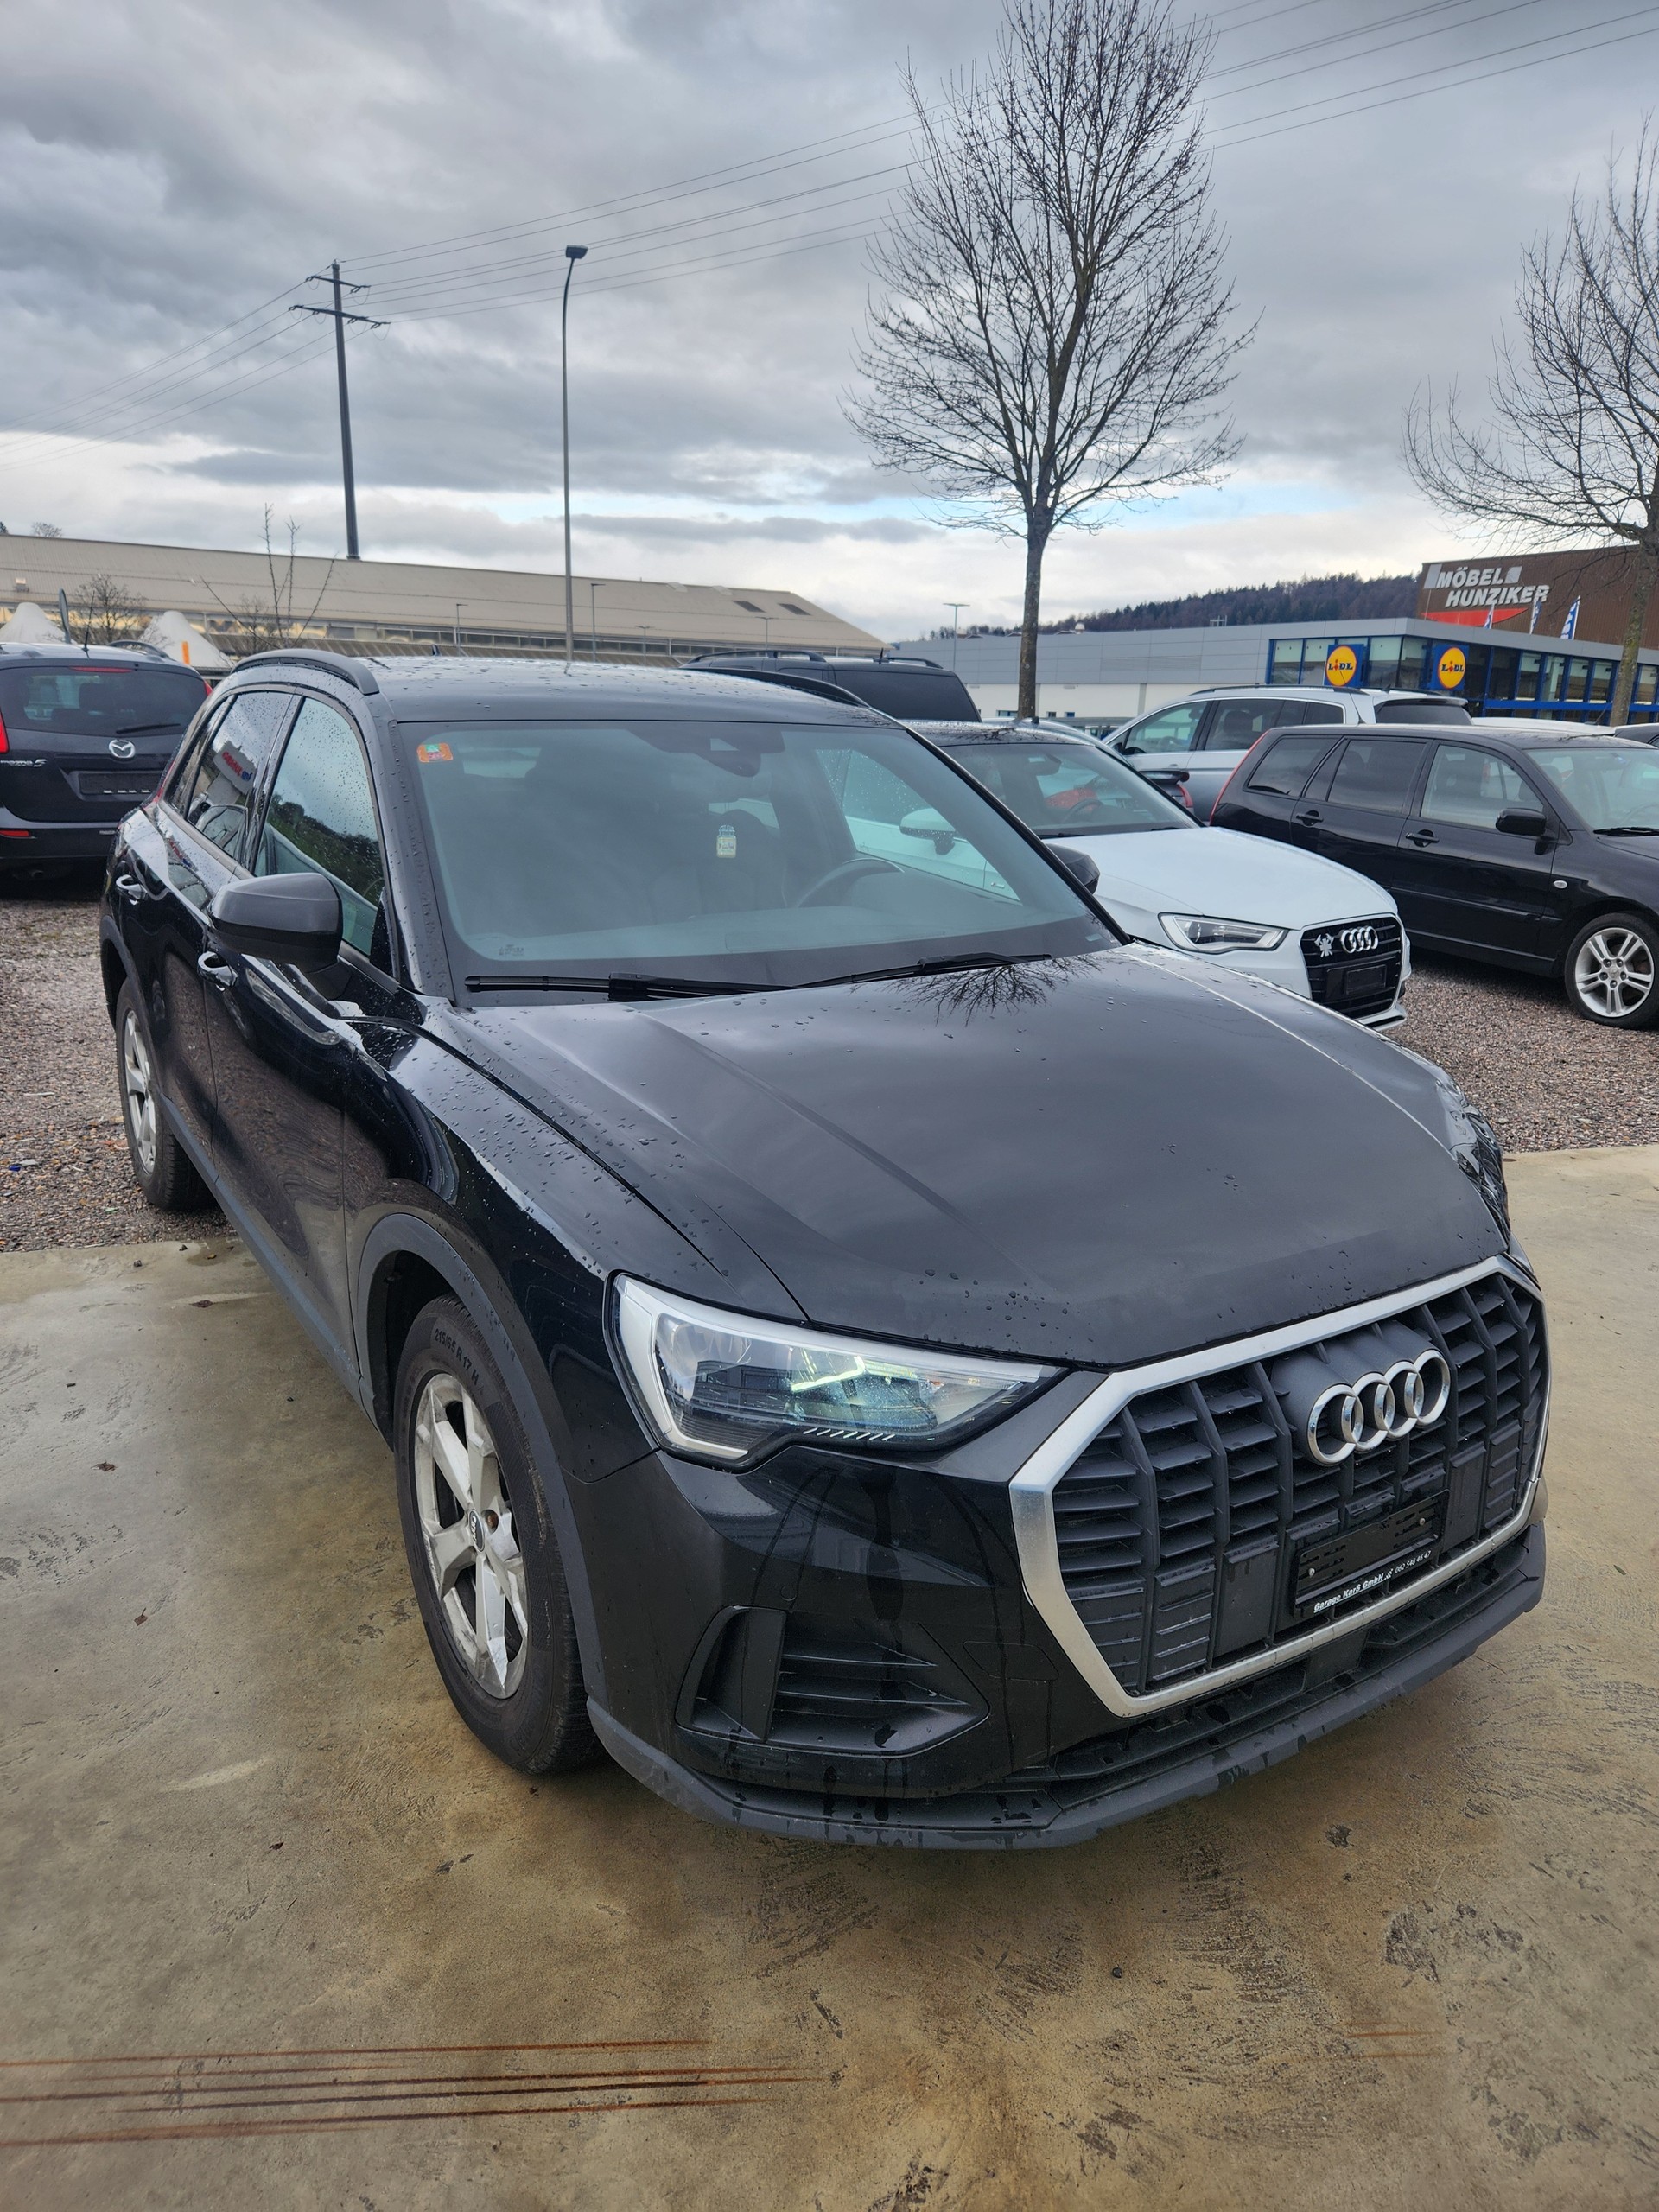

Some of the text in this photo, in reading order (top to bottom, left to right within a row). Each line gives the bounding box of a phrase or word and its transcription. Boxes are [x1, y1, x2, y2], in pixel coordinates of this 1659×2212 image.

[1435, 566, 1503, 589] MÖBEL
[1445, 584, 1550, 608] HUNZIKER
[435, 1328, 480, 1386] 215/65 R 17 H
[1313, 1594, 1342, 1612] Garage
[1362, 1573, 1384, 1590] GmbH
